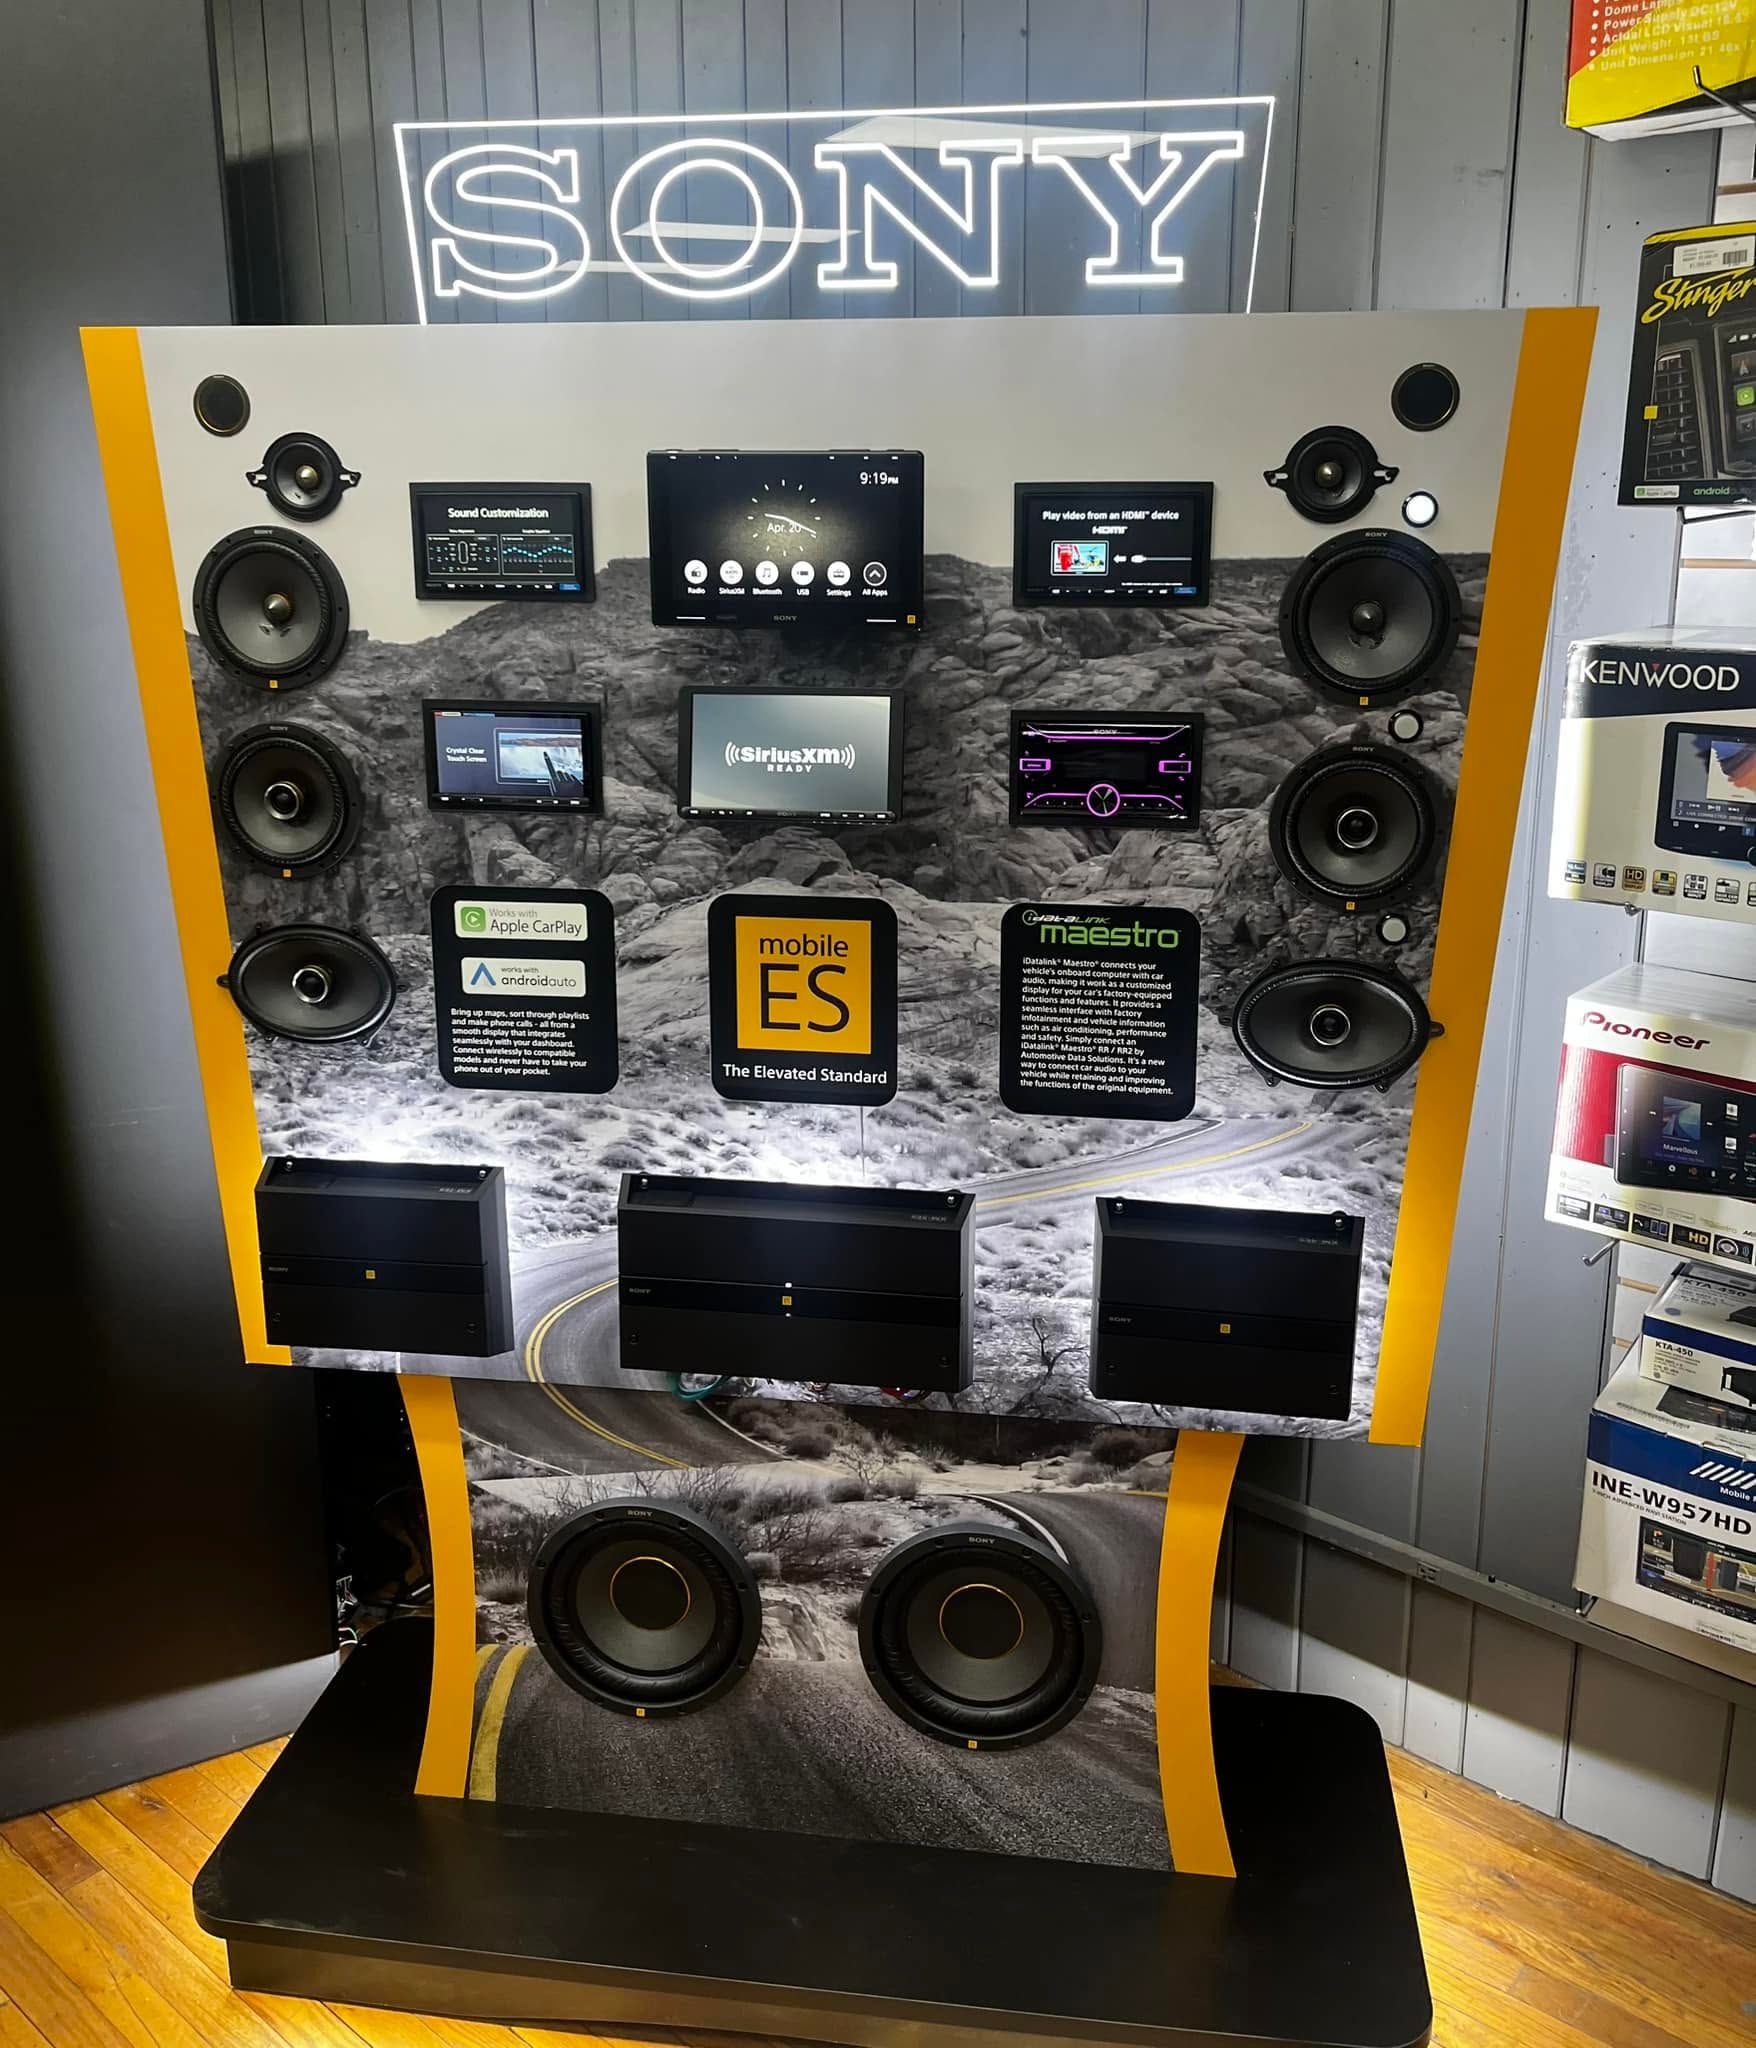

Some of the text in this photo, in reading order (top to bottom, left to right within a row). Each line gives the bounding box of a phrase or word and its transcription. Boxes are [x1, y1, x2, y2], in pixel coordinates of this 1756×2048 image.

[1604, 4, 1639, 17] Dome
[1604, 17, 1641, 30] Power
[424, 131, 1245, 302] SONY
[1640, 267, 1756, 324] Stinger
[447, 507, 549, 519] Sound Customization
[1042, 511, 1061, 522] Play
[1062, 511, 1086, 520] video
[1087, 510, 1108, 520] from
[1109, 512, 1120, 520] an
[1151, 510, 1179, 520] device
[767, 523, 787, 534] Apr.
[687, 586, 706, 595] Radio
[752, 587, 783, 596] Bluetooth
[797, 588, 810, 597] USB
[826, 588, 852, 598] Settings
[862, 588, 888, 598] All Apps
[1579, 659, 1740, 691] KENWOOD
[446, 747, 485, 756] Crystal Clear
[467, 755, 487, 763] Screen
[767, 764, 813, 773] READY
[1626, 870, 1643, 880] HD
[489, 908, 538, 918] Works with
[490, 919, 582, 936] Apple CarPlay
[1040, 921, 1179, 948] maestro
[759, 933, 849, 957] mobile
[1022, 966, 1055, 975] vehicle's
[1057, 968, 1090, 976] onboard
[1092, 971, 1130, 979] computer
[1132, 971, 1149, 979] with
[501, 975, 577, 988] androidauto
[1022, 976, 1046, 984] audio,
[1048, 977, 1077, 987] making
[1125, 981, 1171, 989] customized
[760, 963, 850, 1033] ES
[1022, 994, 1058, 1003] functions
[1059, 996, 1075, 1004] and
[1076, 997, 1110, 1006] features.
[1120, 1000, 1154, 1008] provides
[451, 1007, 471, 1017] Bring
[484, 1010, 508, 1018] maps,
[526, 1010, 557, 1020] through
[558, 1011, 589, 1020] playlists
[1022, 1004, 1057, 1013] seamless
[1059, 1006, 1093, 1014] interface
[1114, 1008, 1142, 1018] factory
[1021, 1013, 1165, 1027] infotainment and vehicle information
[482, 1027, 509, 1037] display
[510, 1028, 526, 1036] that
[527, 1029, 565, 1038] integrates
[1583, 1011, 1711, 1051] Pioneer
[452, 1036, 574, 1047] seamlessly with your dashboard.
[453, 1045, 484, 1053] Connect
[485, 1047, 522, 1056] wirelessly
[533, 1049, 575, 1057] compatible
[1020, 1050, 1065, 1060] Automotive
[1067, 1053, 1086, 1061] Data
[1087, 1054, 1125, 1063] Solutions.
[1128, 1056, 1139, 1064] It's
[453, 1055, 481, 1063] models
[522, 1057, 540, 1065] have
[551, 1058, 568, 1066] take
[569, 1060, 586, 1068] your
[454, 1064, 478, 1073] phone
[494, 1065, 502, 1073] of
[504, 1067, 521, 1075] your
[522, 1067, 550, 1075] pocket.
[722, 1064, 887, 1084] The Elevated Standard
[1020, 1069, 1165, 1086] vehicle while retaining and improving
[1020, 1078, 1173, 1094] the functions of the original equipment.
[1689, 1232, 1709, 1245] HD
[1656, 1341, 1693, 1356] KTA-450
[1720, 1487, 1750, 1501] Mobile
[1593, 1470, 1751, 1535] INE-W957HD
[1612, 1497, 1644, 1511] ADVANCED
[1646, 1508, 1661, 1517] NAVI
[1662, 1513, 1687, 1526] STATION
[968, 1536, 995, 1544] SONY
